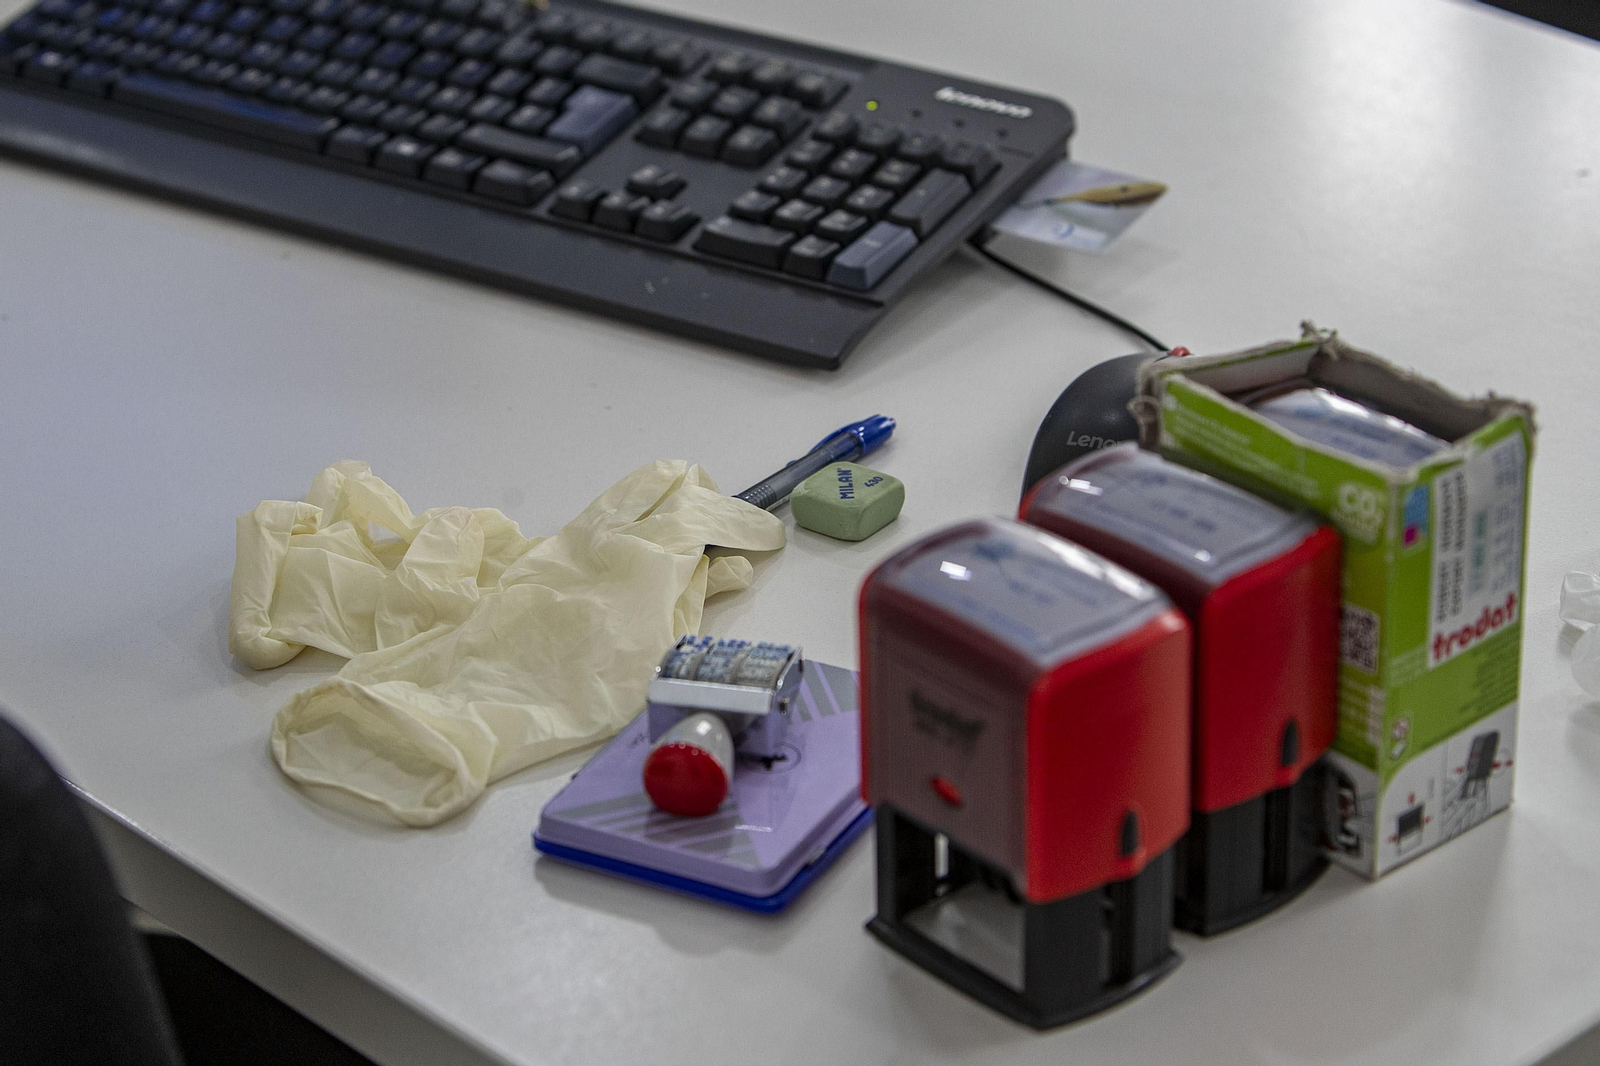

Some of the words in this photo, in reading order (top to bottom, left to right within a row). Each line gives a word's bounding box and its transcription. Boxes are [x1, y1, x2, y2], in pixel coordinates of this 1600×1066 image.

[1066, 431, 1118, 449] Leno
[837, 469, 855, 499] MILAN
[864, 476, 884, 488] 430
[1433, 591, 1517, 661] trodat
